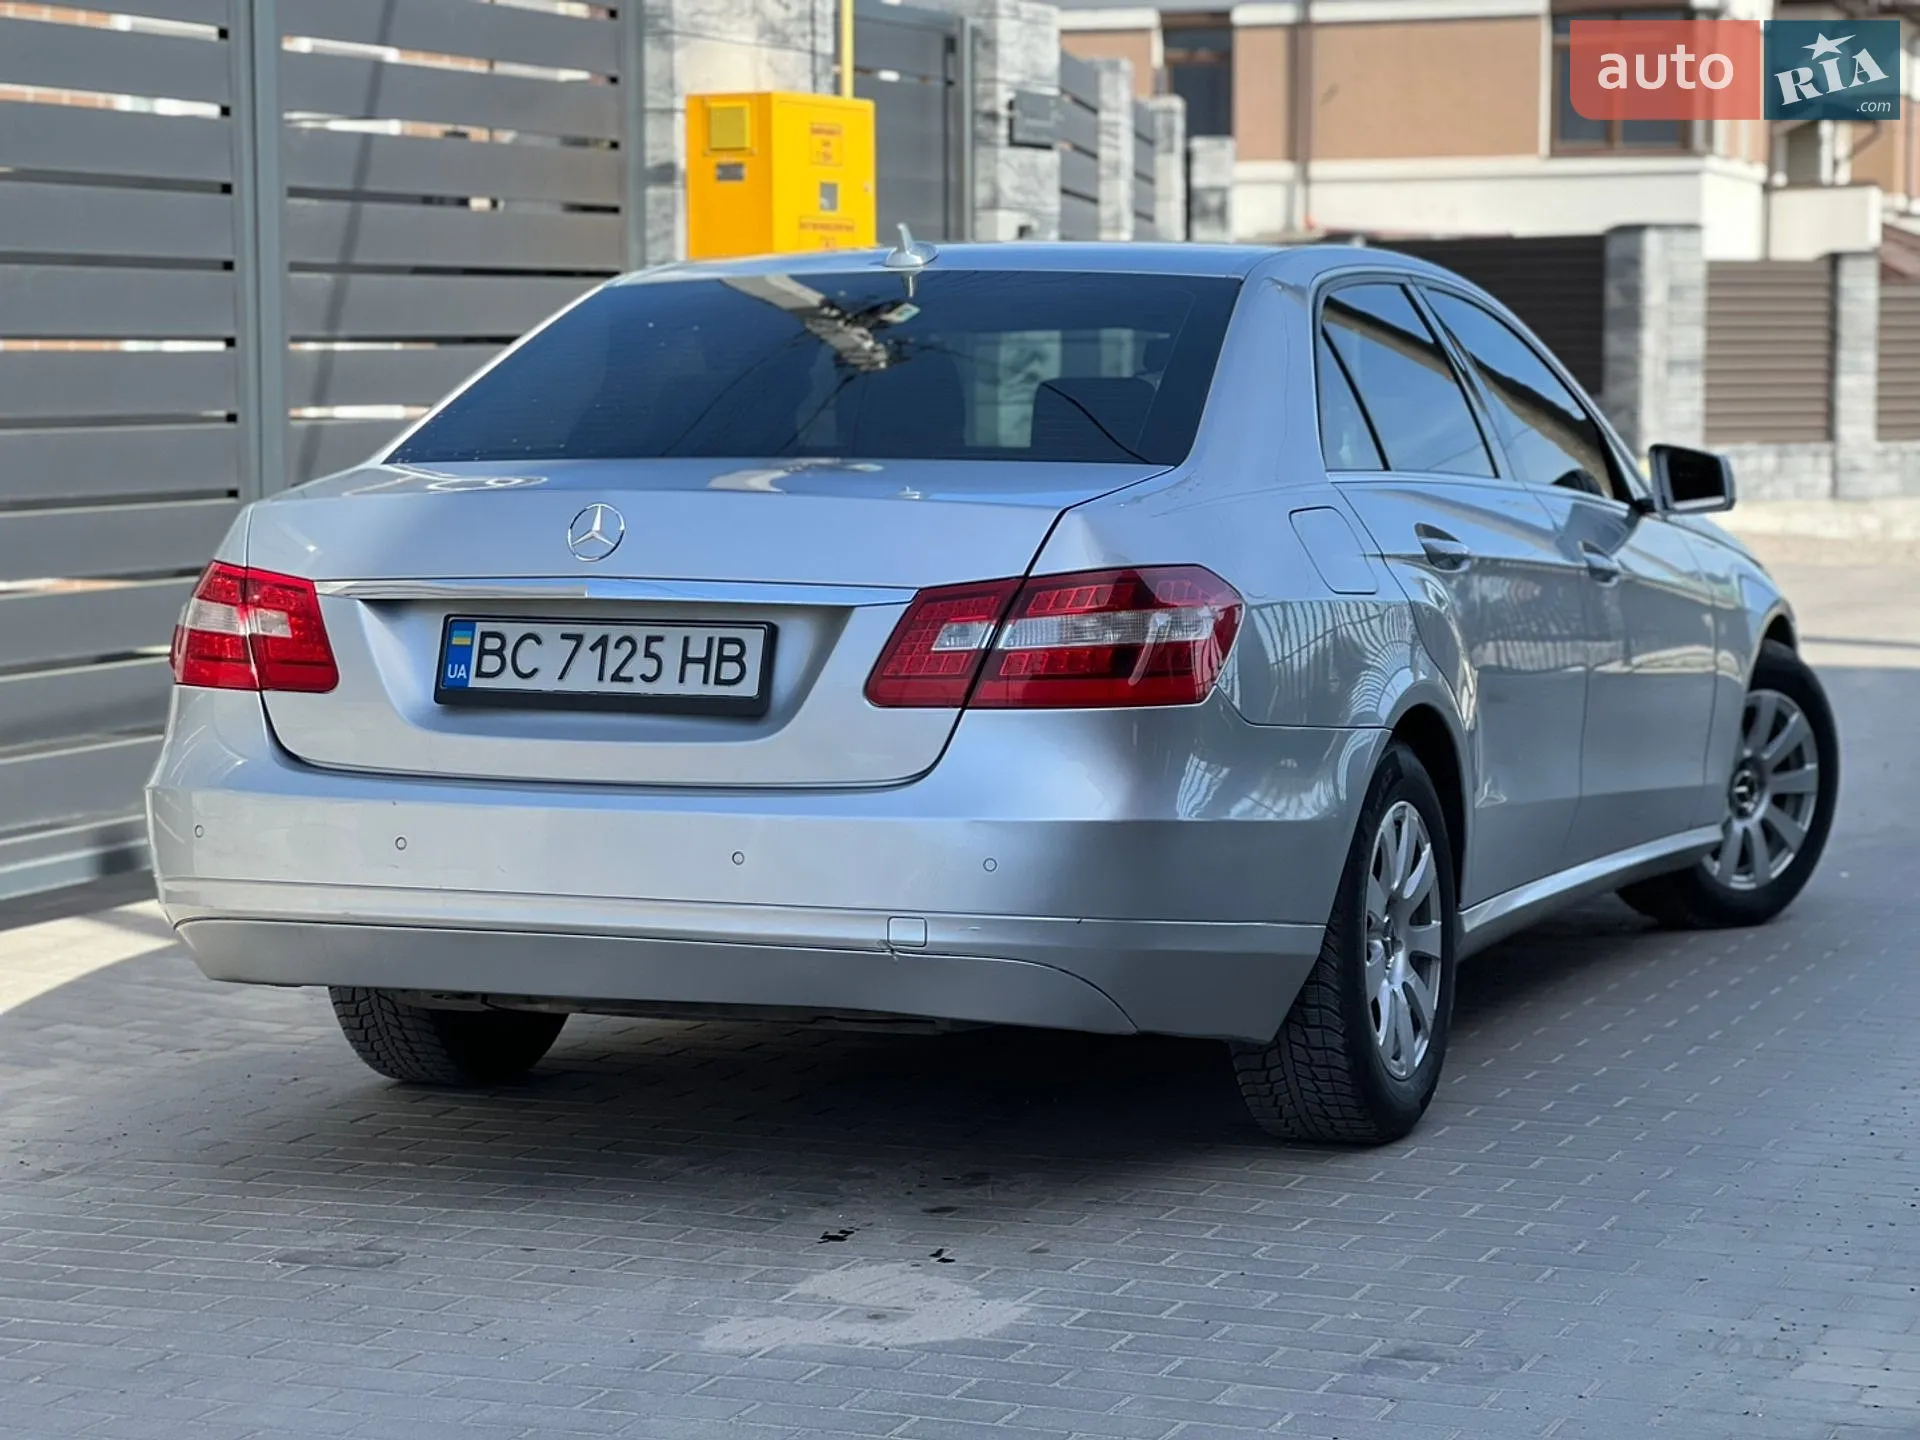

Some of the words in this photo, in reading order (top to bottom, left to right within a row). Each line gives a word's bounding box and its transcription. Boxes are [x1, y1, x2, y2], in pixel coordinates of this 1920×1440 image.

[447, 663, 468, 680] UA
[475, 631, 543, 680] BC
[557, 633, 665, 684] 7125
[679, 635, 747, 686] HB
